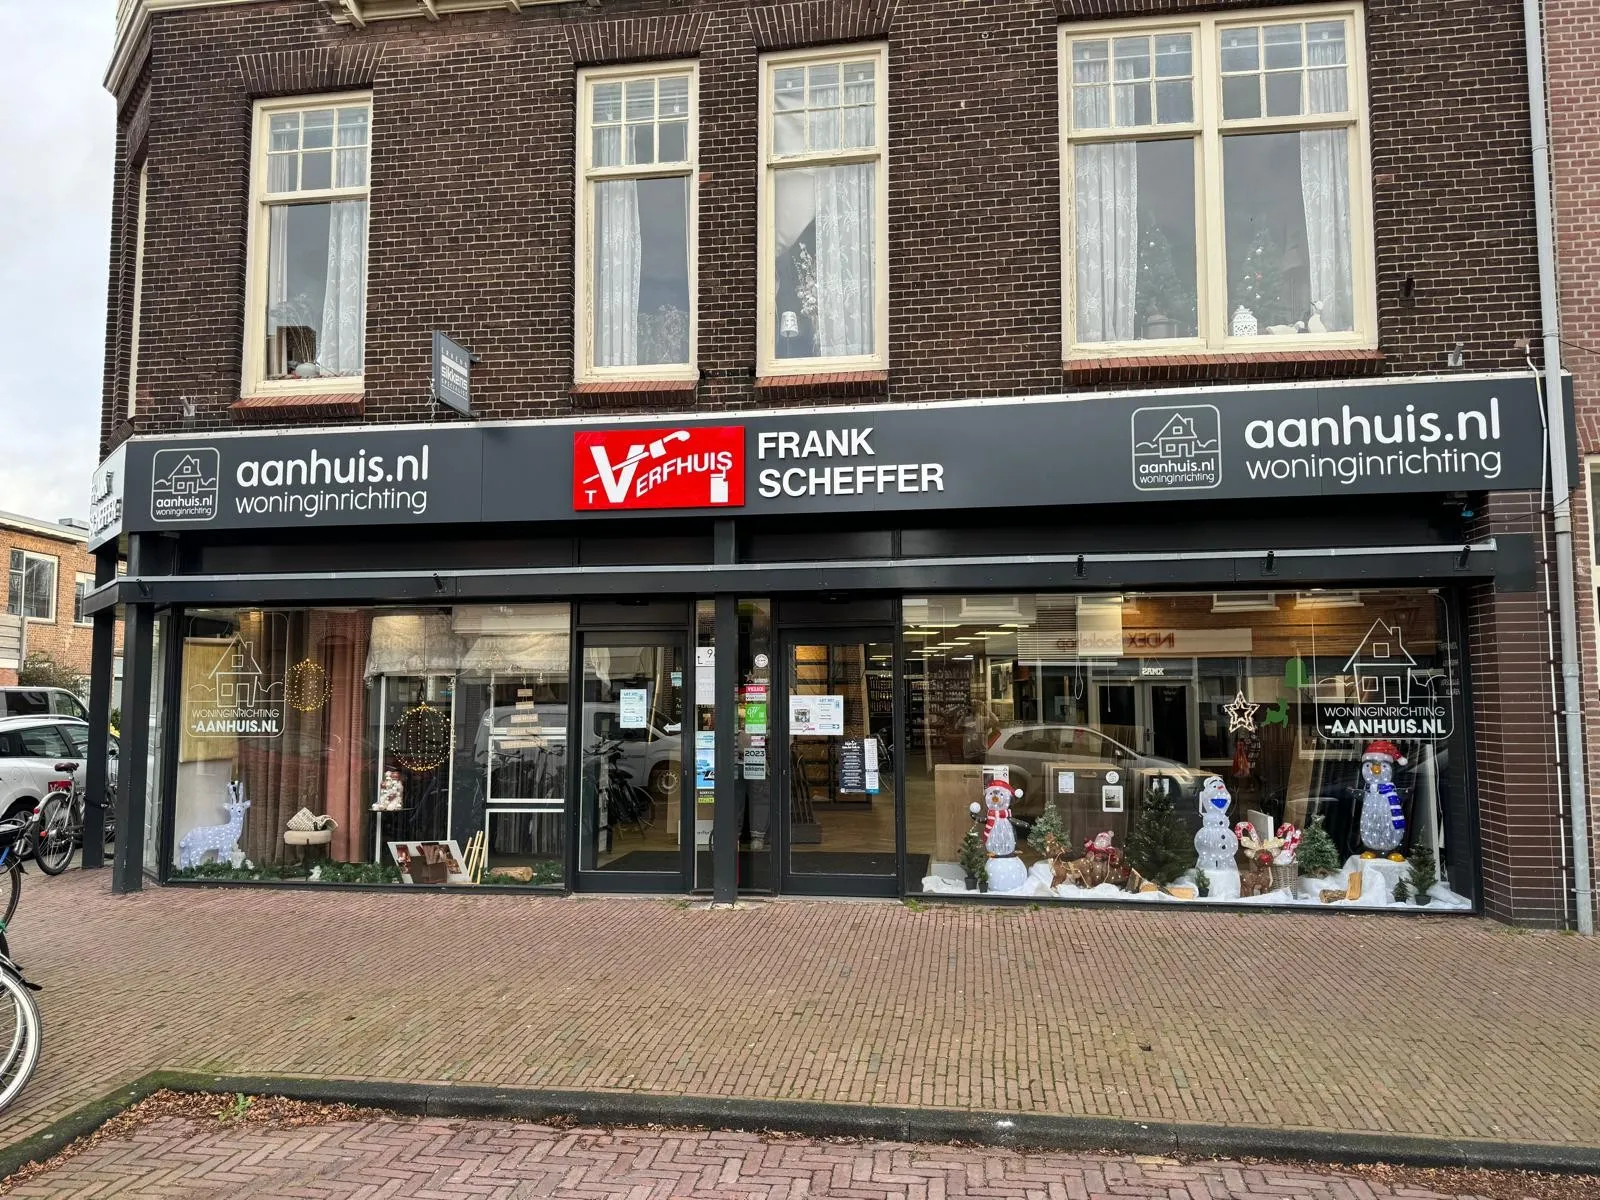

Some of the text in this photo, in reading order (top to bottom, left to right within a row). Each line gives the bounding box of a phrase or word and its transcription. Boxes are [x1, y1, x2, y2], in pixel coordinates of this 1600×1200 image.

[1244, 397, 1501, 449] aanhuis.nl
[758, 427, 875, 460] FRANK
[236, 444, 430, 488] aanhuis.nl
[1139, 458, 1215, 474] aanhuis.nl
[1139, 470, 1215, 485] woninginrichting
[1246, 446, 1502, 485] woninginrichting
[758, 463, 945, 498] SCHEFFER
[155, 505, 212, 518] woninginrichting
[156, 494, 213, 508] aanhuis.nl
[235, 486, 428, 518] woninginrichting
[192, 708, 280, 719] WONINGINRICHTING
[1324, 706, 1446, 717] WONINGINRICHTING
